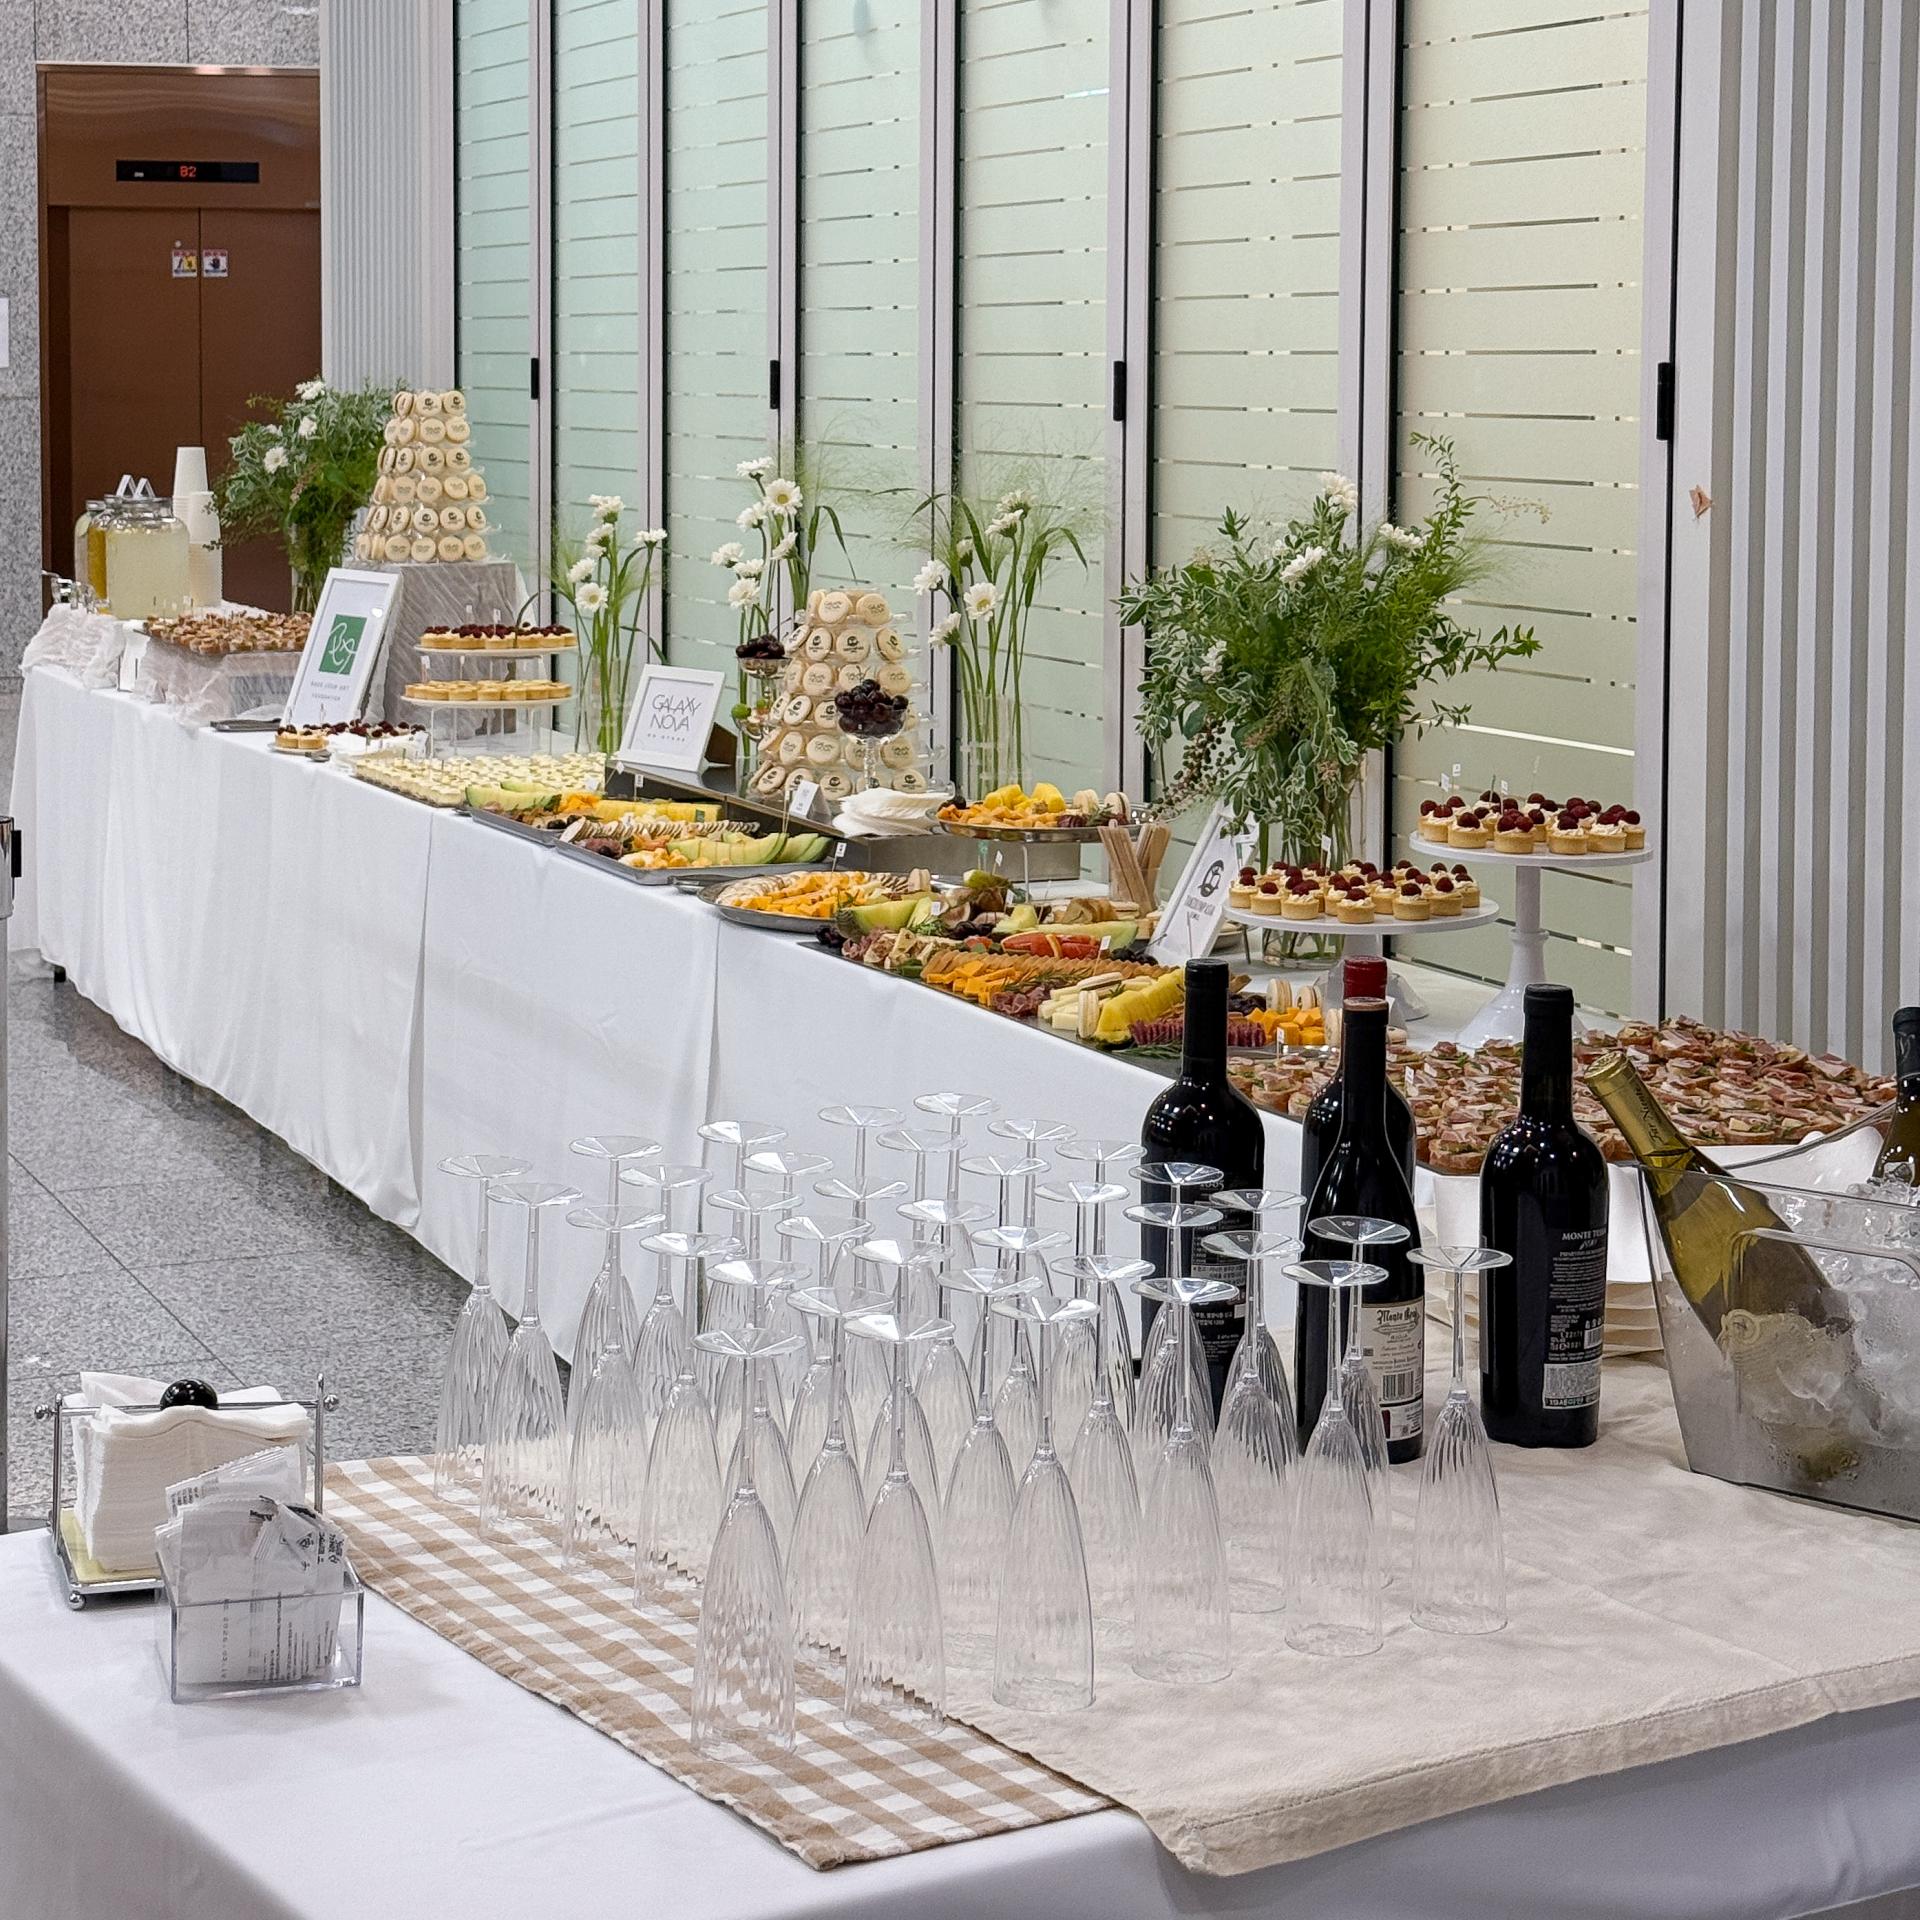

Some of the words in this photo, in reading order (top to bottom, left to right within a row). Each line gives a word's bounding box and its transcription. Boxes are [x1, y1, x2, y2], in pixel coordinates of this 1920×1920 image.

[180, 166, 197, 178] B2
[652, 694, 702, 717] GALAXY
[650, 713, 690, 732] NOVA
[1561, 1230, 1593, 1241] MONTE
[1376, 1310, 1403, 1325] Monte
